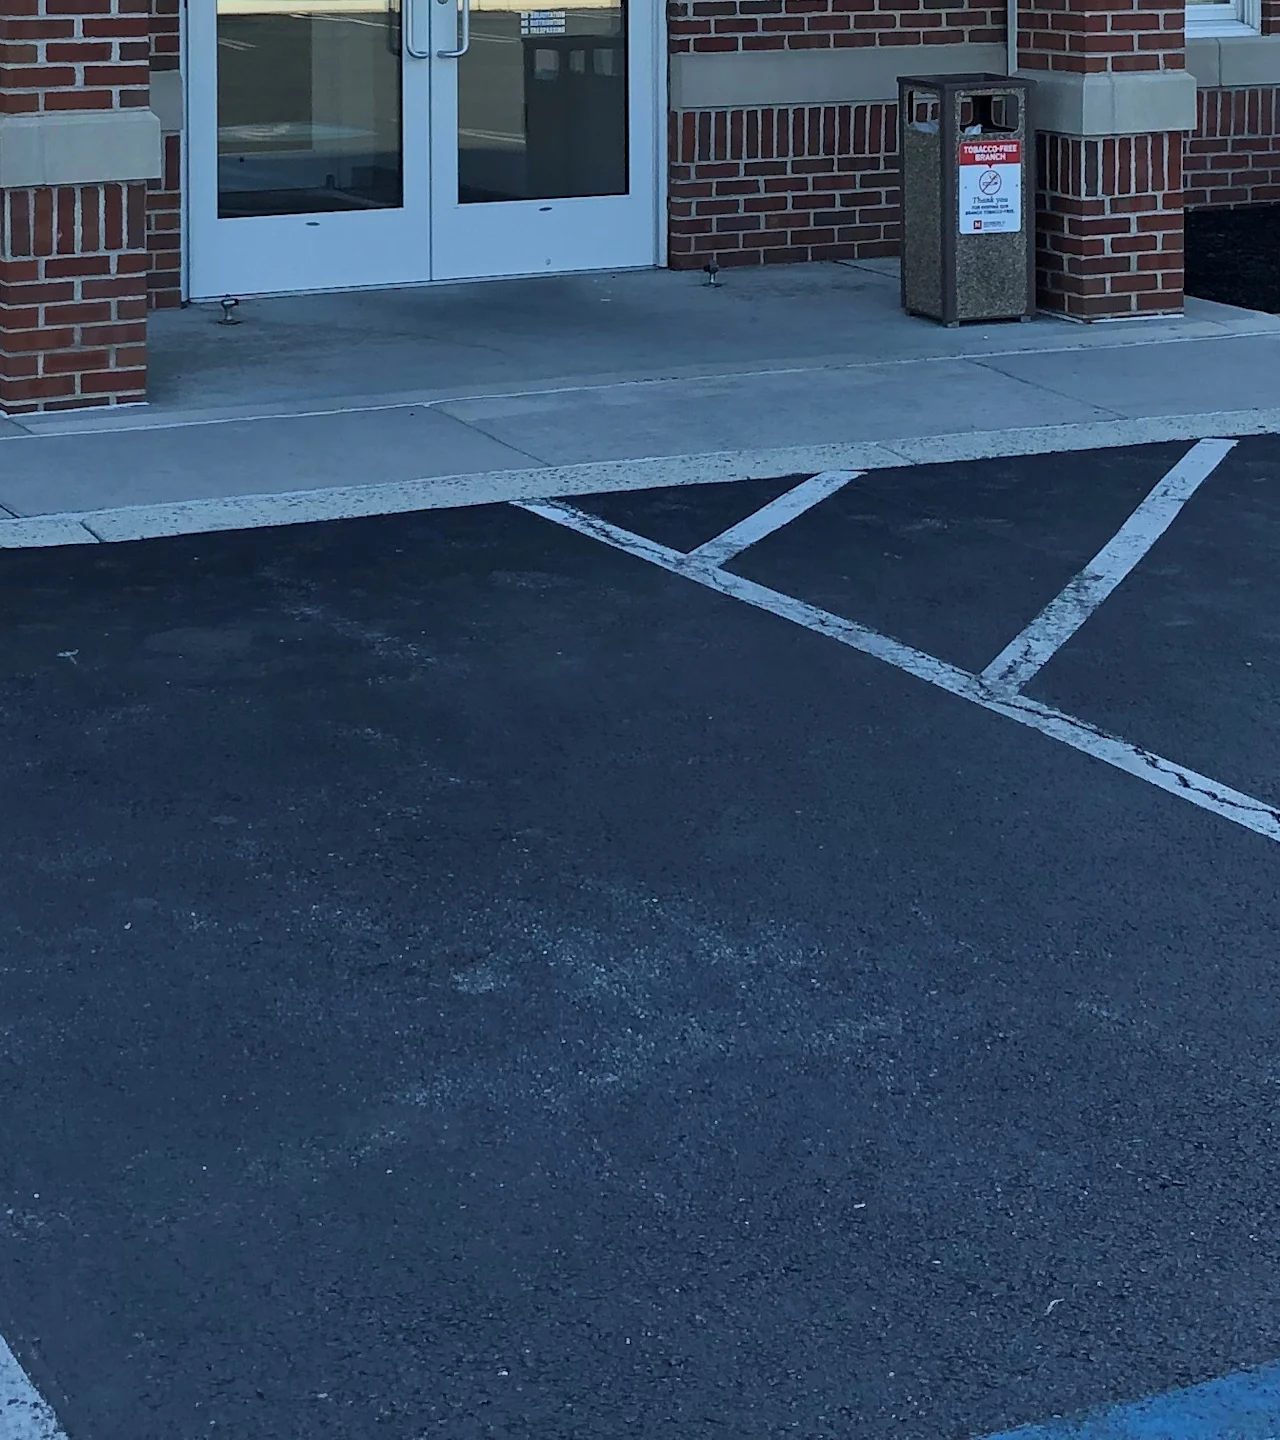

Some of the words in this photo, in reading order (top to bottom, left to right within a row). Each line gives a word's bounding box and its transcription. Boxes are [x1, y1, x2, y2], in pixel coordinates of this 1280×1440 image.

[963, 144, 1017, 153] TOBACCO-FREE
[975, 153, 1006, 161] BRANCH
[972, 196, 994, 204] Thank
[995, 197, 1008, 205] you
